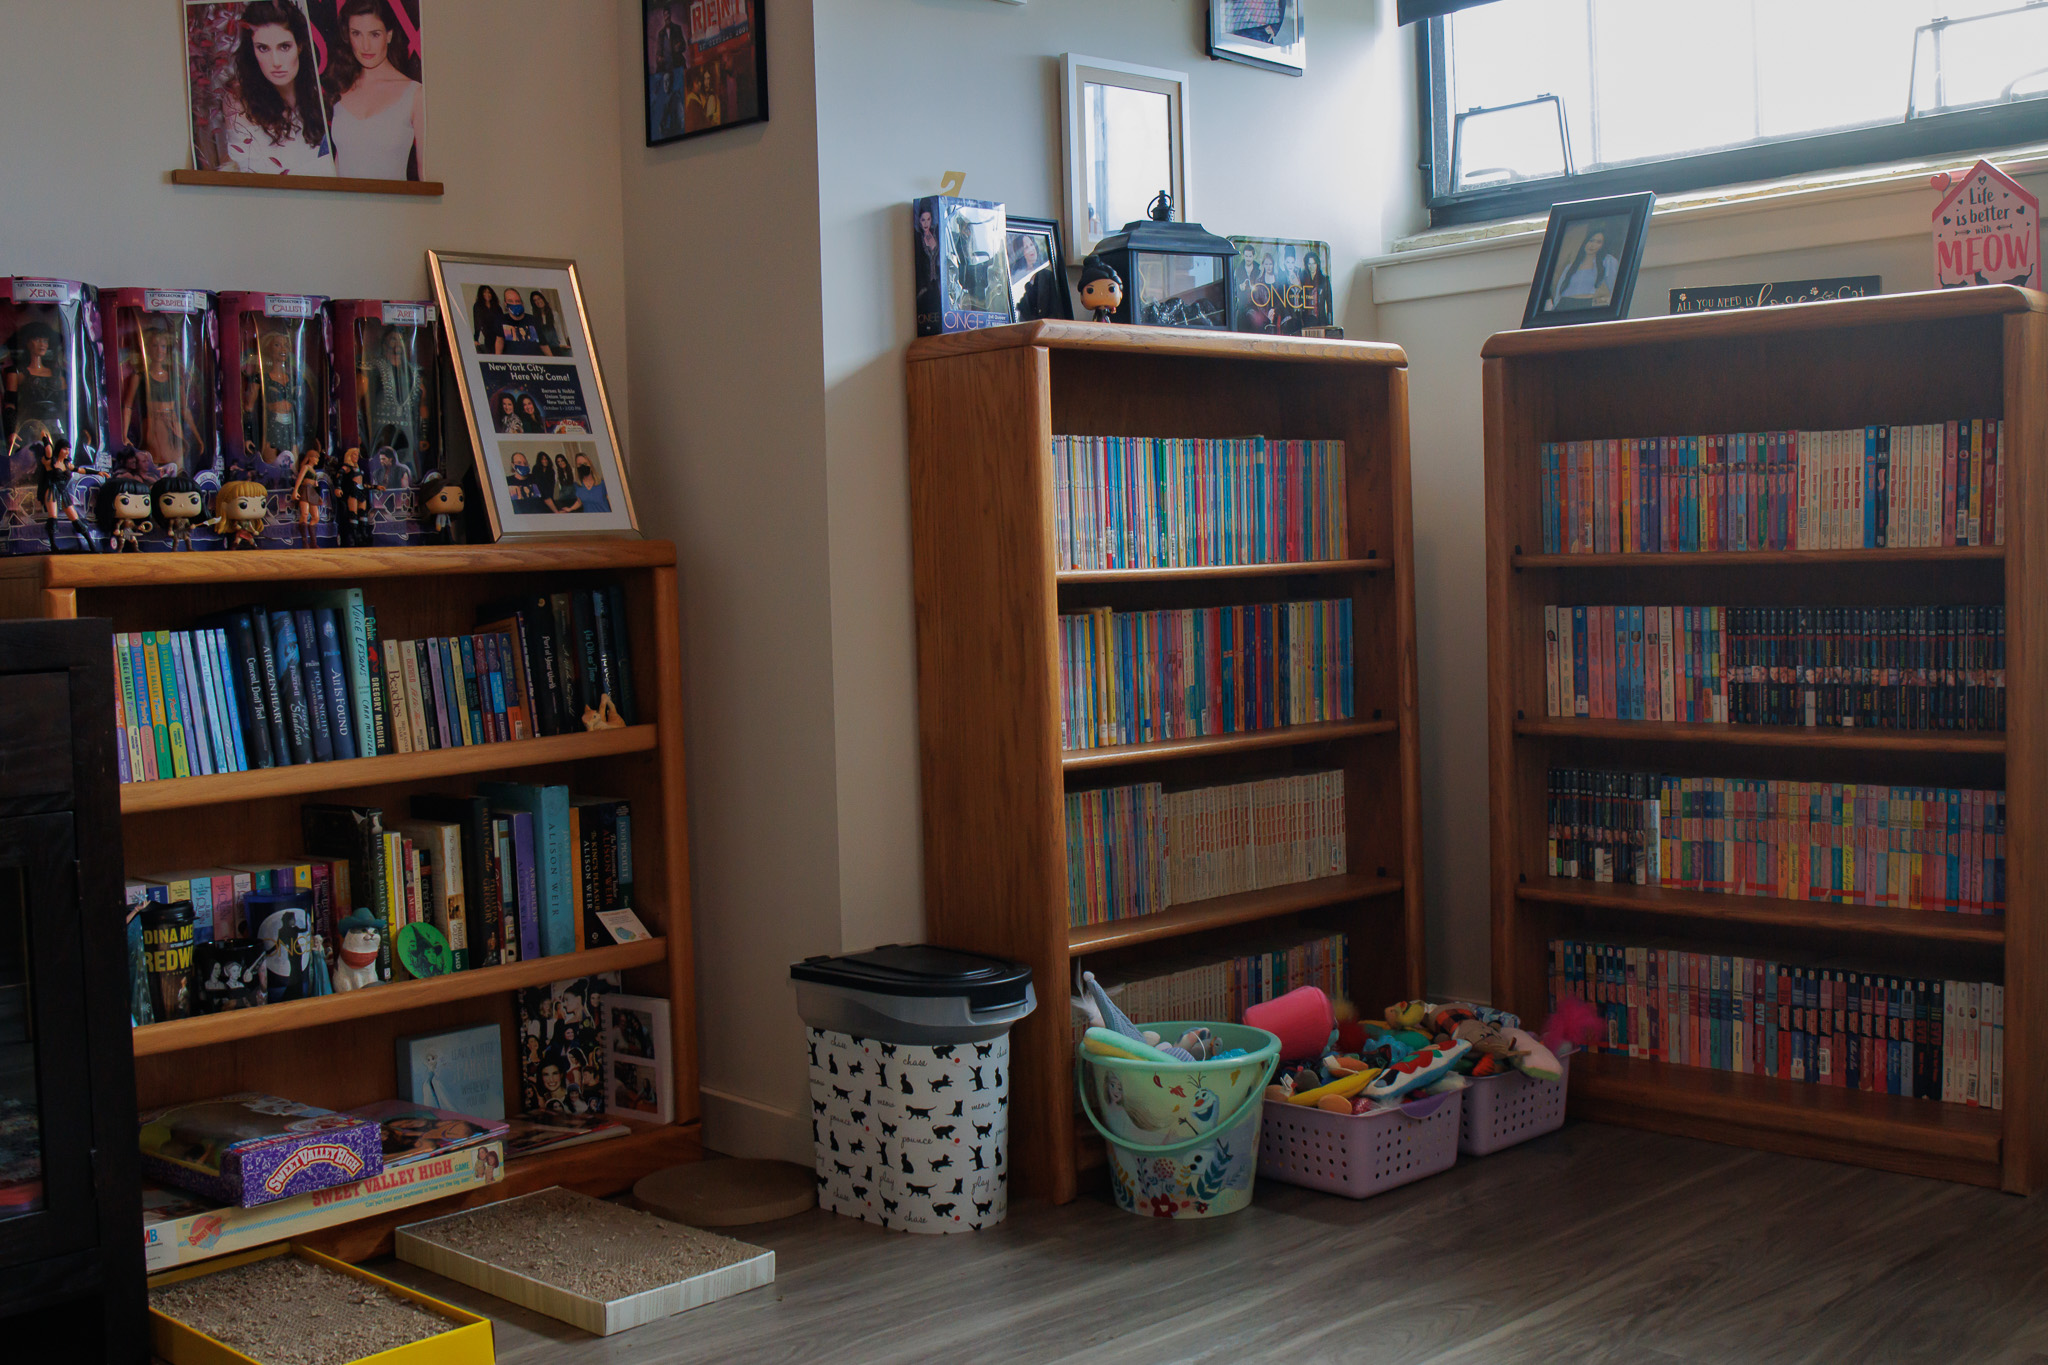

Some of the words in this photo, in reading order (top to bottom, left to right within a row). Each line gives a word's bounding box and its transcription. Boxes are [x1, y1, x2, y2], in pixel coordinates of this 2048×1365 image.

[691, 0, 742, 33] RENT
[1969, 186, 1995, 206] Life
[1956, 208, 1967, 227] is
[1969, 205, 2010, 224] better
[1975, 223, 1992, 235] with
[1937, 230, 2030, 278] MEOW
[28, 288, 58, 298] XENA
[1250, 282, 1315, 309] ONCE
[1677, 302, 1693, 312] ALL
[1696, 298, 1714, 308] YOU
[1717, 296, 1741, 308] NEED
[1745, 295, 1754, 306] IS
[943, 310, 984, 330] ONCE
[488, 363, 506, 372] New
[507, 363, 525, 372] York
[526, 364, 546, 373] City,
[510, 372, 530, 380] Here
[546, 373, 570, 382] Come!
[352, 603, 363, 633] VOICE
[355, 637, 368, 678] LESSONS
[585, 641, 597, 654] Old
[122, 652, 130, 674] SWEET
[135, 652, 143, 675] SWEET
[162, 650, 173, 672] SWEET
[247, 658, 259, 686] Conceal,
[542, 636, 552, 648] Part
[547, 671, 557, 689] World
[125, 677, 134, 699] VALLEY
[137, 676, 145, 700] VALLEY
[148, 652, 156, 673] SWEET
[153, 698, 163, 722] Twins
[166, 674, 175, 696] VALLEY
[252, 686, 263, 703] Don't
[265, 654, 277, 690] FROZEN
[271, 692, 283, 725] HEART
[371, 676, 382, 712] GREGORY
[388, 670, 404, 718] Beaches
[140, 700, 151, 724] Twins
[169, 697, 180, 721] Twins
[313, 671, 325, 701] POLAR
[319, 703, 330, 738] NIGHTS
[362, 700, 370, 721] CARA
[290, 703, 304, 746] Shadows
[336, 698, 348, 737] FOUND
[363, 722, 374, 757] MENTZEL
[375, 714, 386, 749] MAGUIRE
[549, 824, 558, 875] ALISON
[584, 841, 592, 879] ALISON
[604, 829, 612, 872] ALISON
[622, 842, 630, 879] PICOULT
[376, 853, 385, 877] ANNE
[379, 880, 388, 913] BOLEYN
[482, 878, 493, 925] GREGORY
[552, 883, 561, 917] WEIR
[605, 876, 614, 905] WEIR
[1681, 993, 1690, 1014] SVU
[1734, 999, 1744, 1022] SVU
[1755, 1003, 1765, 1025] SVU
[830, 1035, 848, 1050] chase
[902, 1054, 928, 1067] chase
[877, 1099, 896, 1108] meow
[971, 1102, 991, 1110] meow
[830, 1114, 852, 1126] pounce
[901, 1136, 933, 1149] pounce
[267, 1156, 301, 1191] SWEET
[298, 1147, 336, 1165] VALLEY
[336, 1147, 361, 1173] HIGH
[878, 1171, 894, 1190] play
[312, 1182, 360, 1207] SWEET
[363, 1170, 414, 1193] VALLEY
[418, 1159, 452, 1180] HIGH
[454, 1162, 469, 1172] GAME
[833, 1188, 850, 1201] chase
[972, 1176, 990, 1195] play
[904, 1210, 928, 1224] chase
[188, 1230, 208, 1246] SWEET
